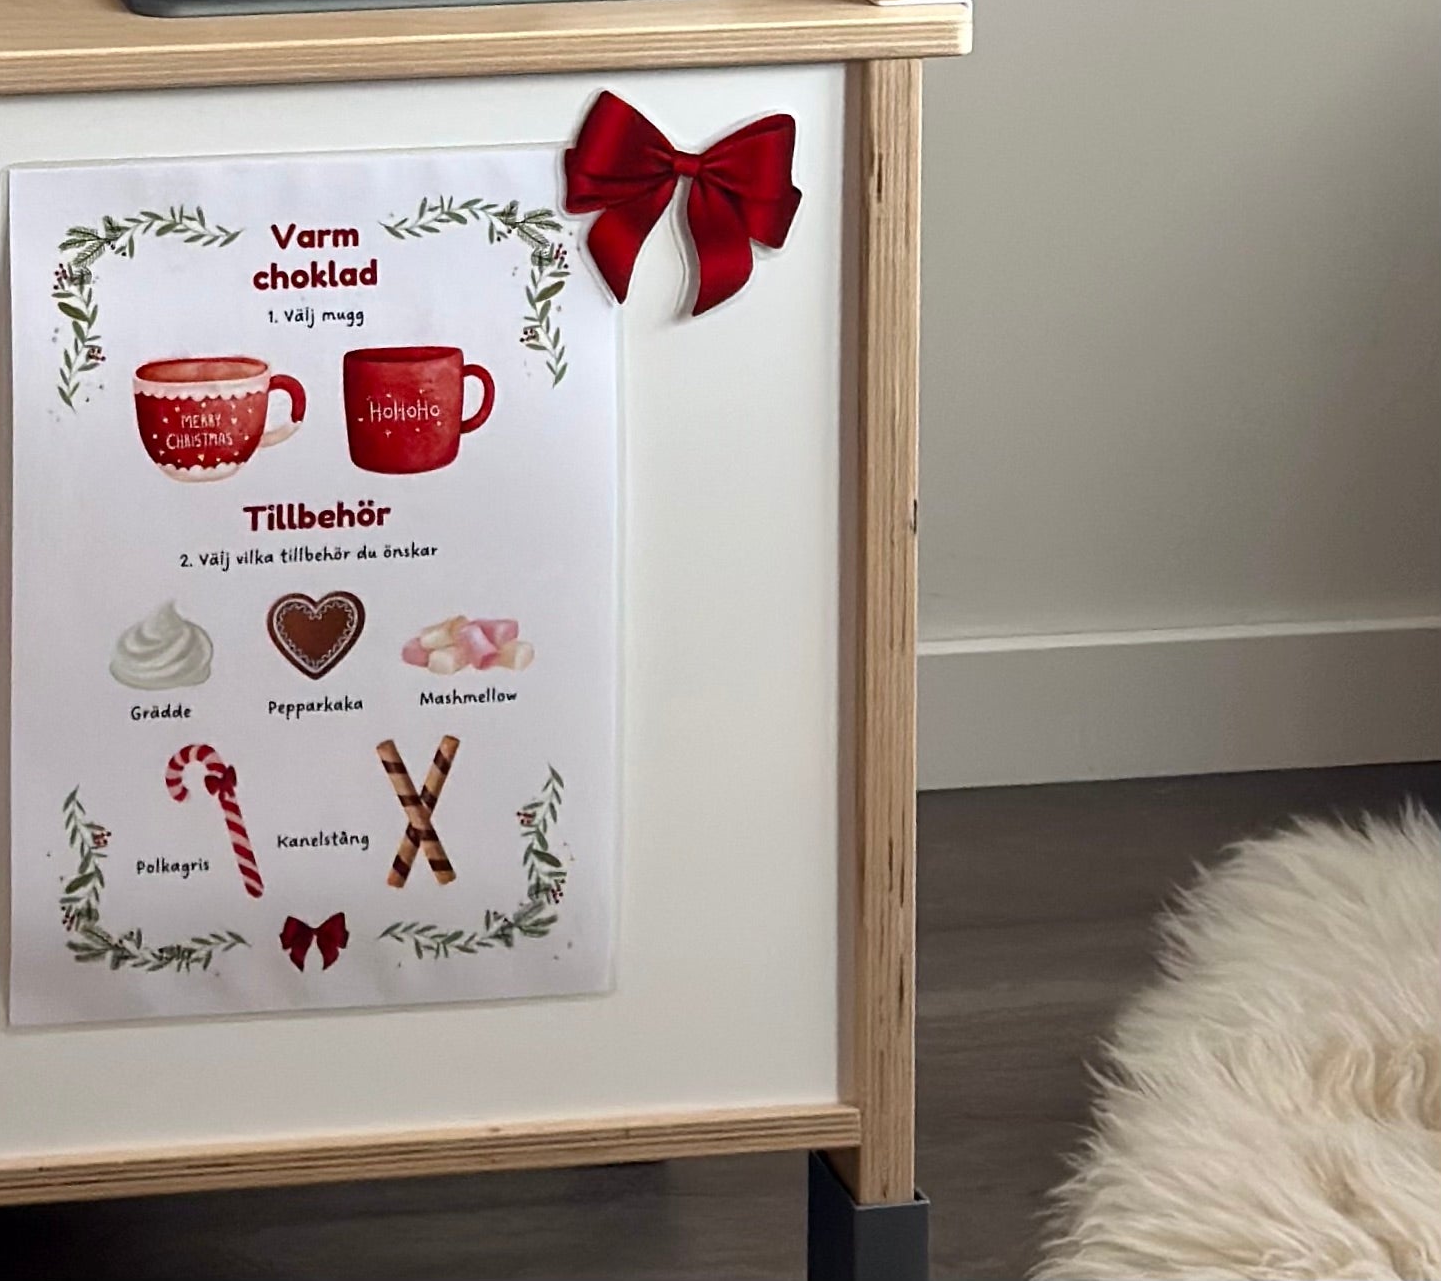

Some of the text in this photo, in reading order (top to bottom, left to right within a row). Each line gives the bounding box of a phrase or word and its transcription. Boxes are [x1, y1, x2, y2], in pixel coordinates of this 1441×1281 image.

[269, 222, 360, 251] Varm
[252, 257, 378, 292] choklad
[267, 306, 365, 328] 1. Välj mugg
[242, 499, 392, 533] Tillbehör
[179, 541, 439, 573] 2. Välj vilka tillbehör du önskar
[268, 694, 364, 717] Pepparkaka
[419, 686, 518, 707] Mashmellow
[130, 702, 192, 722] Grädde
[276, 829, 370, 852] Kanelstång
[136, 856, 210, 880] Polkagris
